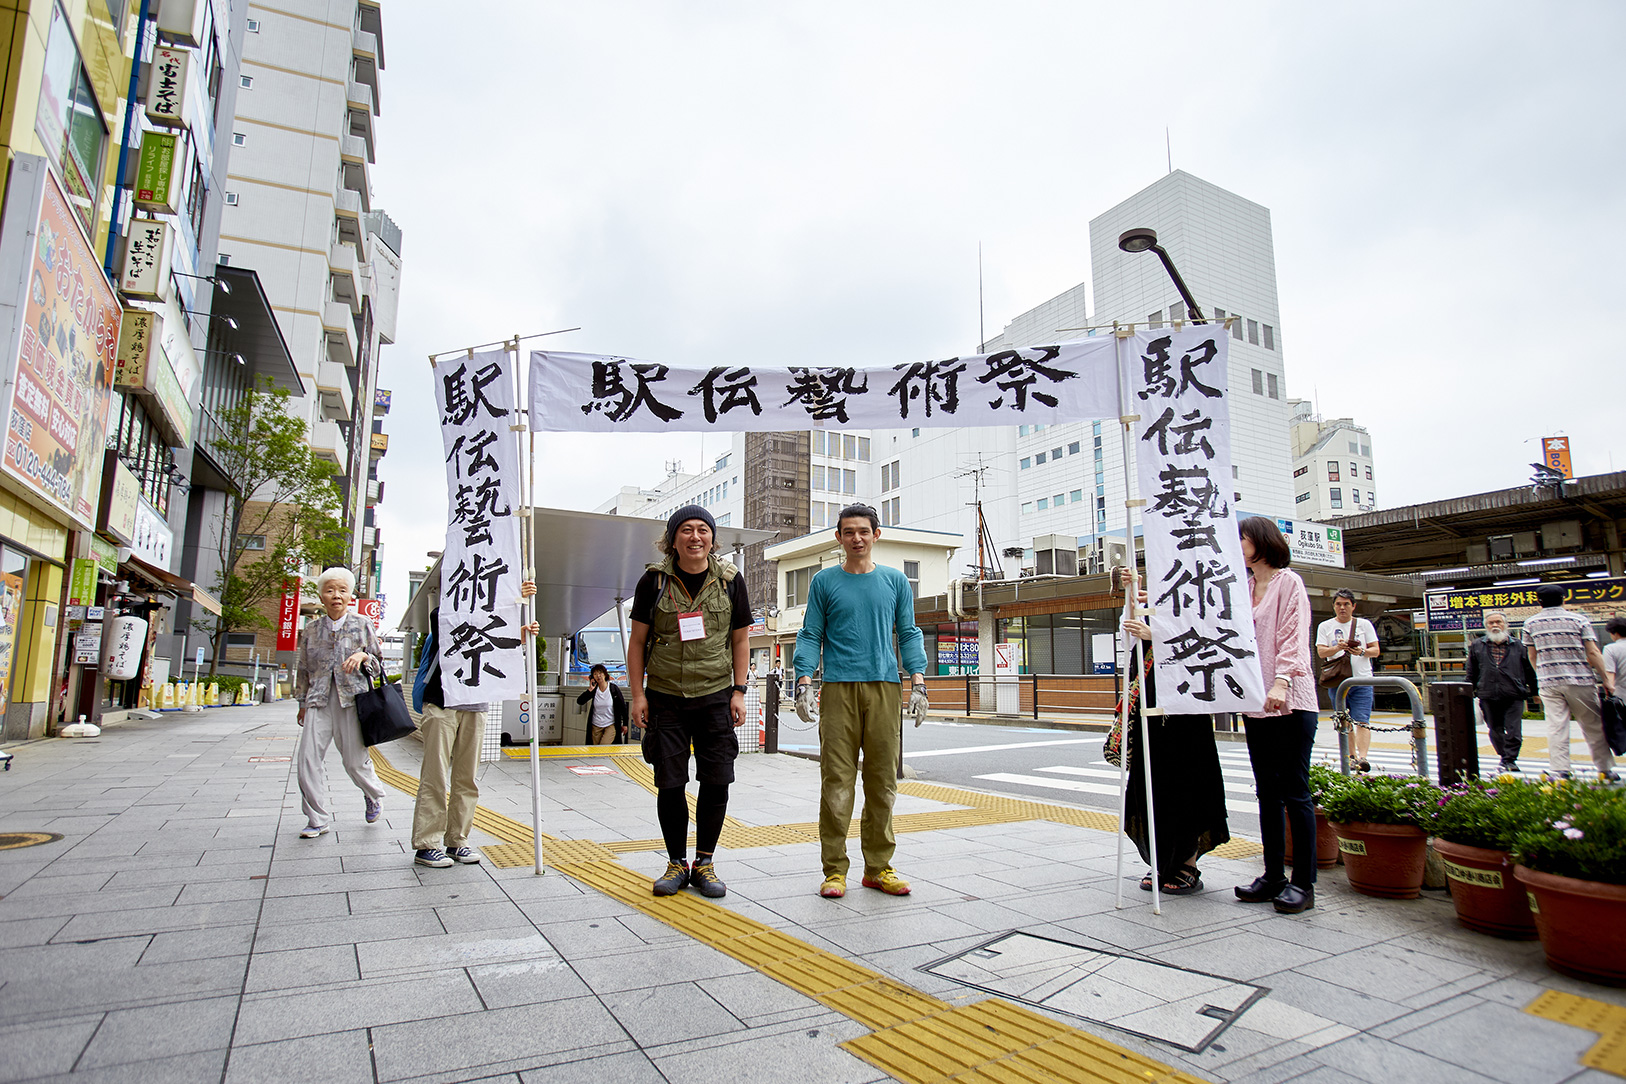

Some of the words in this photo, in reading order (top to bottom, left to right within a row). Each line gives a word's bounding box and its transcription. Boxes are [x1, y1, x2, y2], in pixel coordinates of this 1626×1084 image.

[155, 63, 180, 114] 富士そば
[146, 145, 156, 173] リライフ
[155, 148, 172, 201] お部屋探し専門店
[130, 240, 146, 279] 生そば
[145, 228, 161, 269] 茹でたて
[56, 236, 116, 371] おたからや
[20, 322, 82, 421] 高価現金買取
[129, 316, 148, 376] 濃厚鶏そば
[16, 371, 50, 426] 査定無料
[581, 345, 1080, 424] 駅伝藝術祭
[51, 406, 78, 452] 安心対応
[15, 441, 72, 500] 0120-444-784
[442, 362, 521, 687] 駅伝藝術祭
[1137, 334, 1257, 702] 駅伝藝術祭
[1297, 540, 1316, 549] Ogikubo
[1300, 529, 1320, 542] 荻窪駅
[1449, 585, 1624, 609] 増本整形外科リニック
